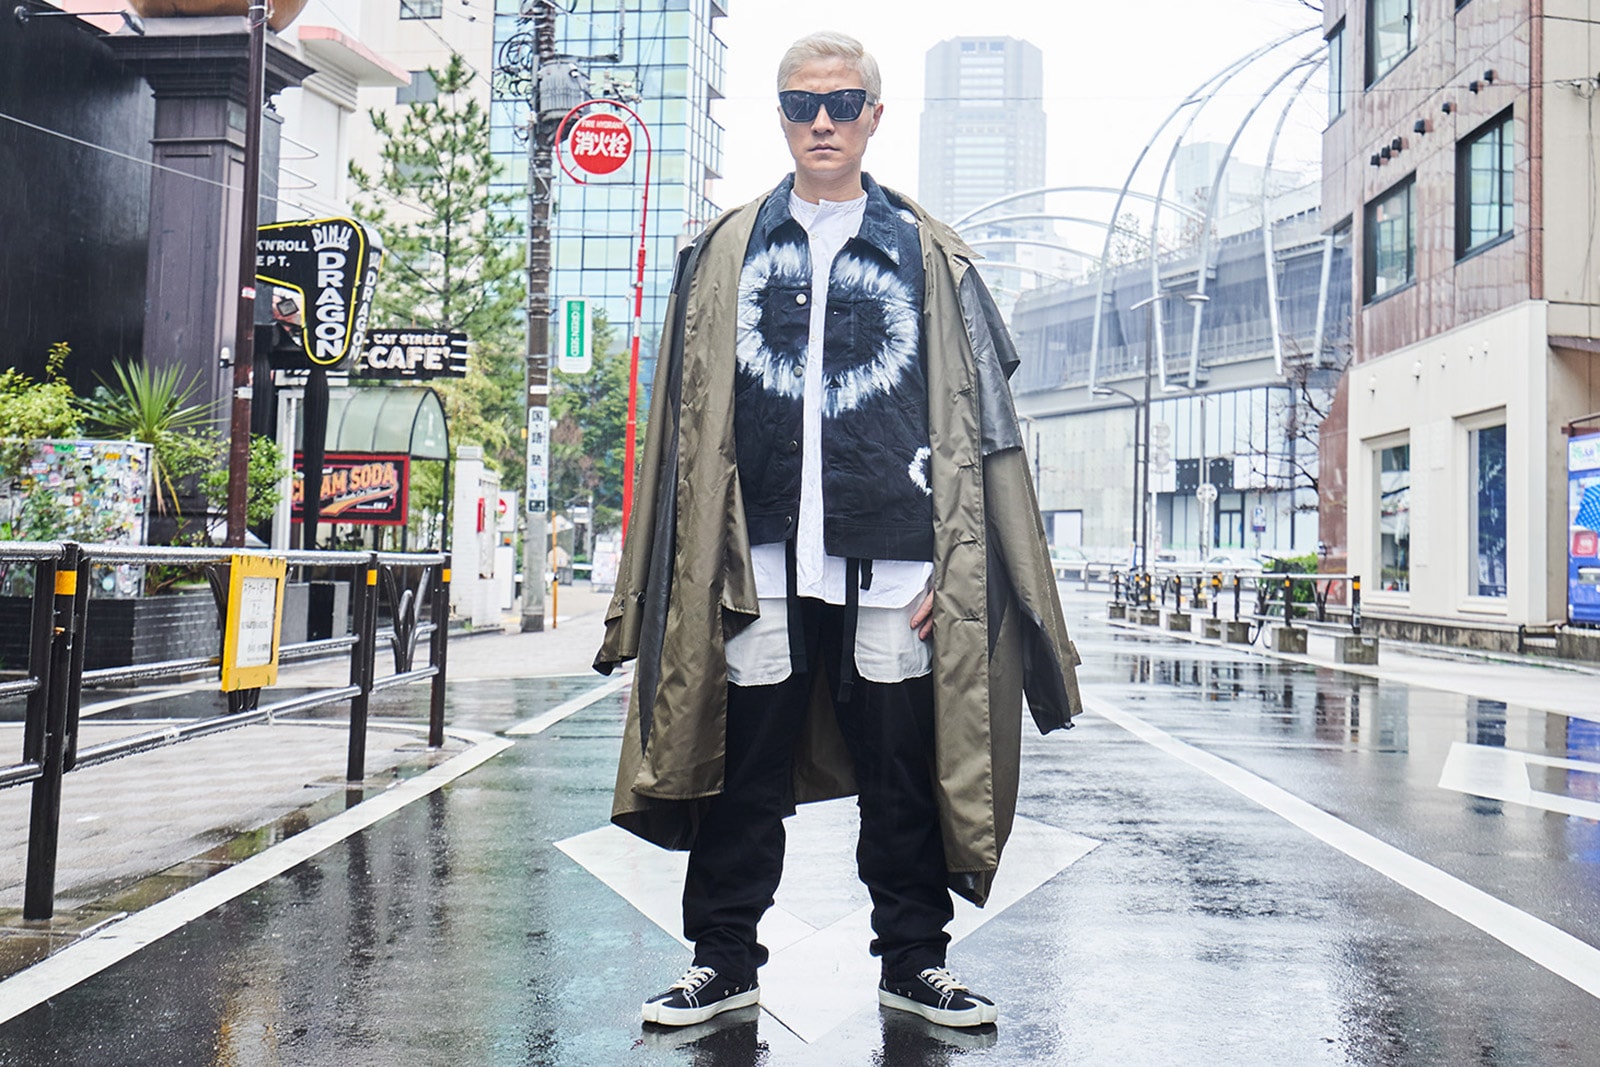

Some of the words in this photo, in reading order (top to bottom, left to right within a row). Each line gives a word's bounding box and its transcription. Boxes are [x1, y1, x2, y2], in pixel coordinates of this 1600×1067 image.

[574, 130, 630, 158] 消火栓
[315, 252, 346, 358] DRAGON
[348, 270, 377, 361] DRAGON
[373, 333, 398, 345] CAT
[399, 333, 449, 346] STREET
[349, 462, 395, 491] SODA
